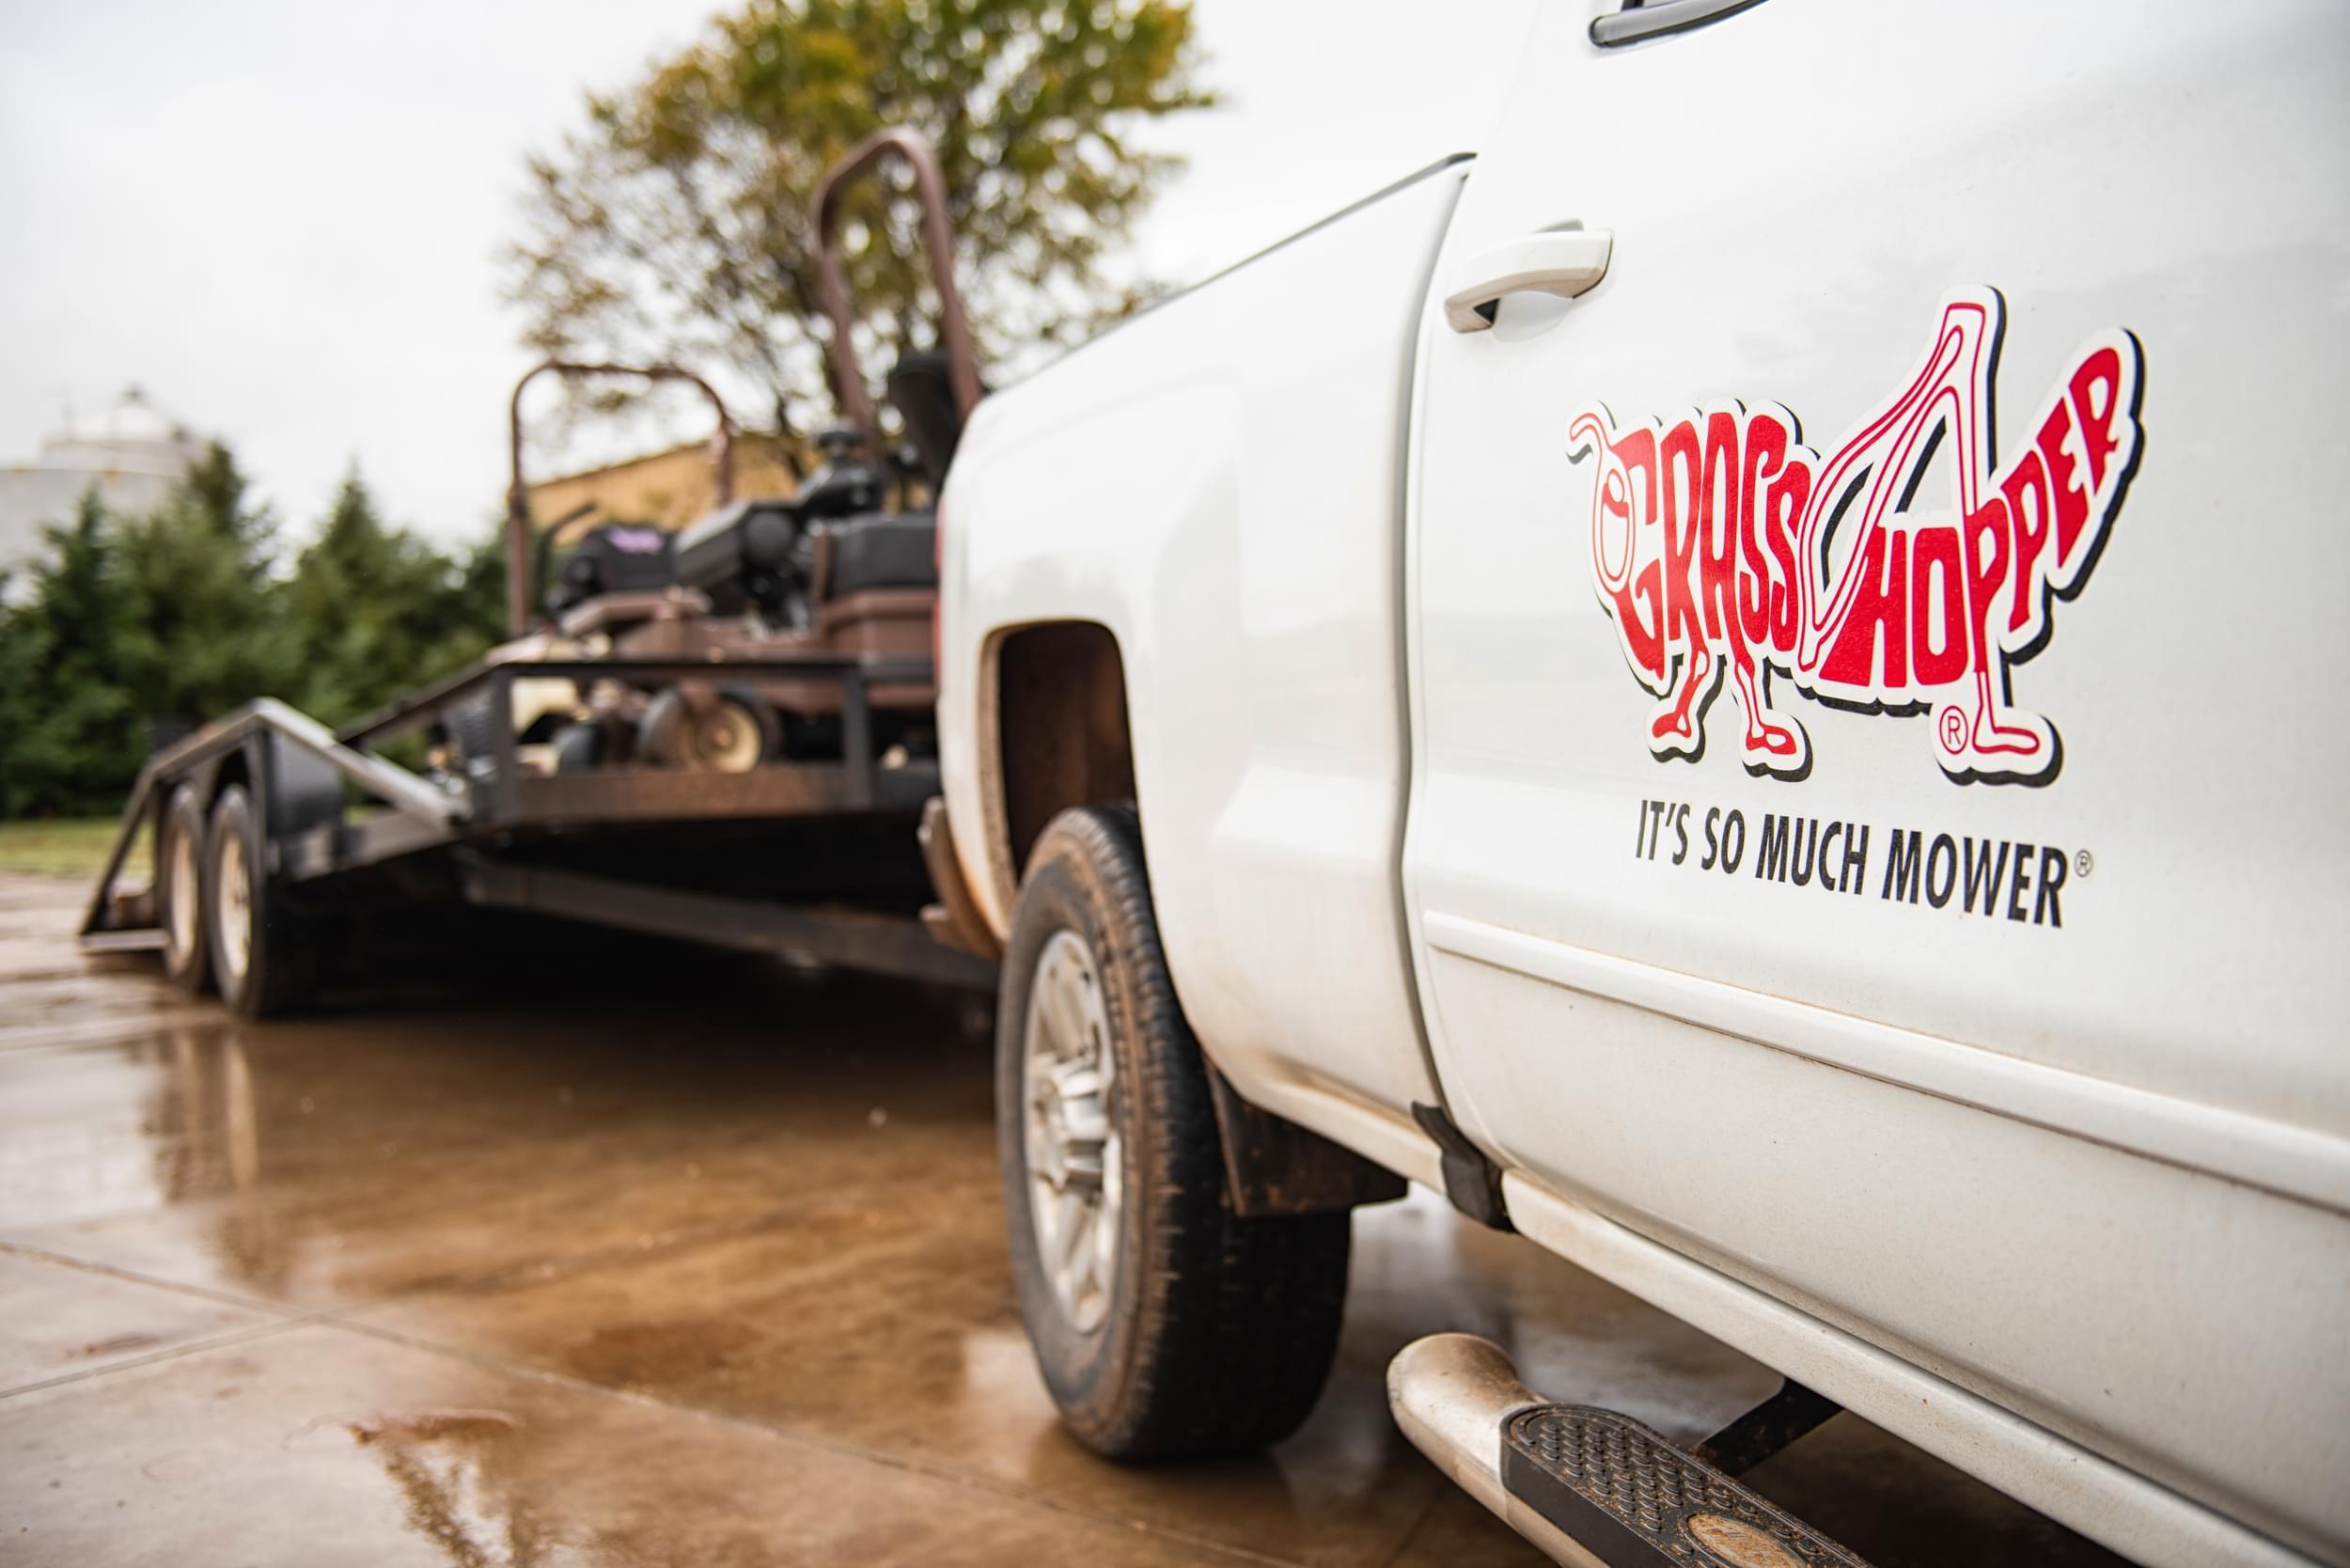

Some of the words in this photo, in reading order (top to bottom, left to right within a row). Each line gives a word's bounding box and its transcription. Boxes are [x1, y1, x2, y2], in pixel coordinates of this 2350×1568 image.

[1636, 799, 1691, 866] IT'S
[1701, 807, 1746, 874] SO
[1755, 814, 1870, 895] MUCH
